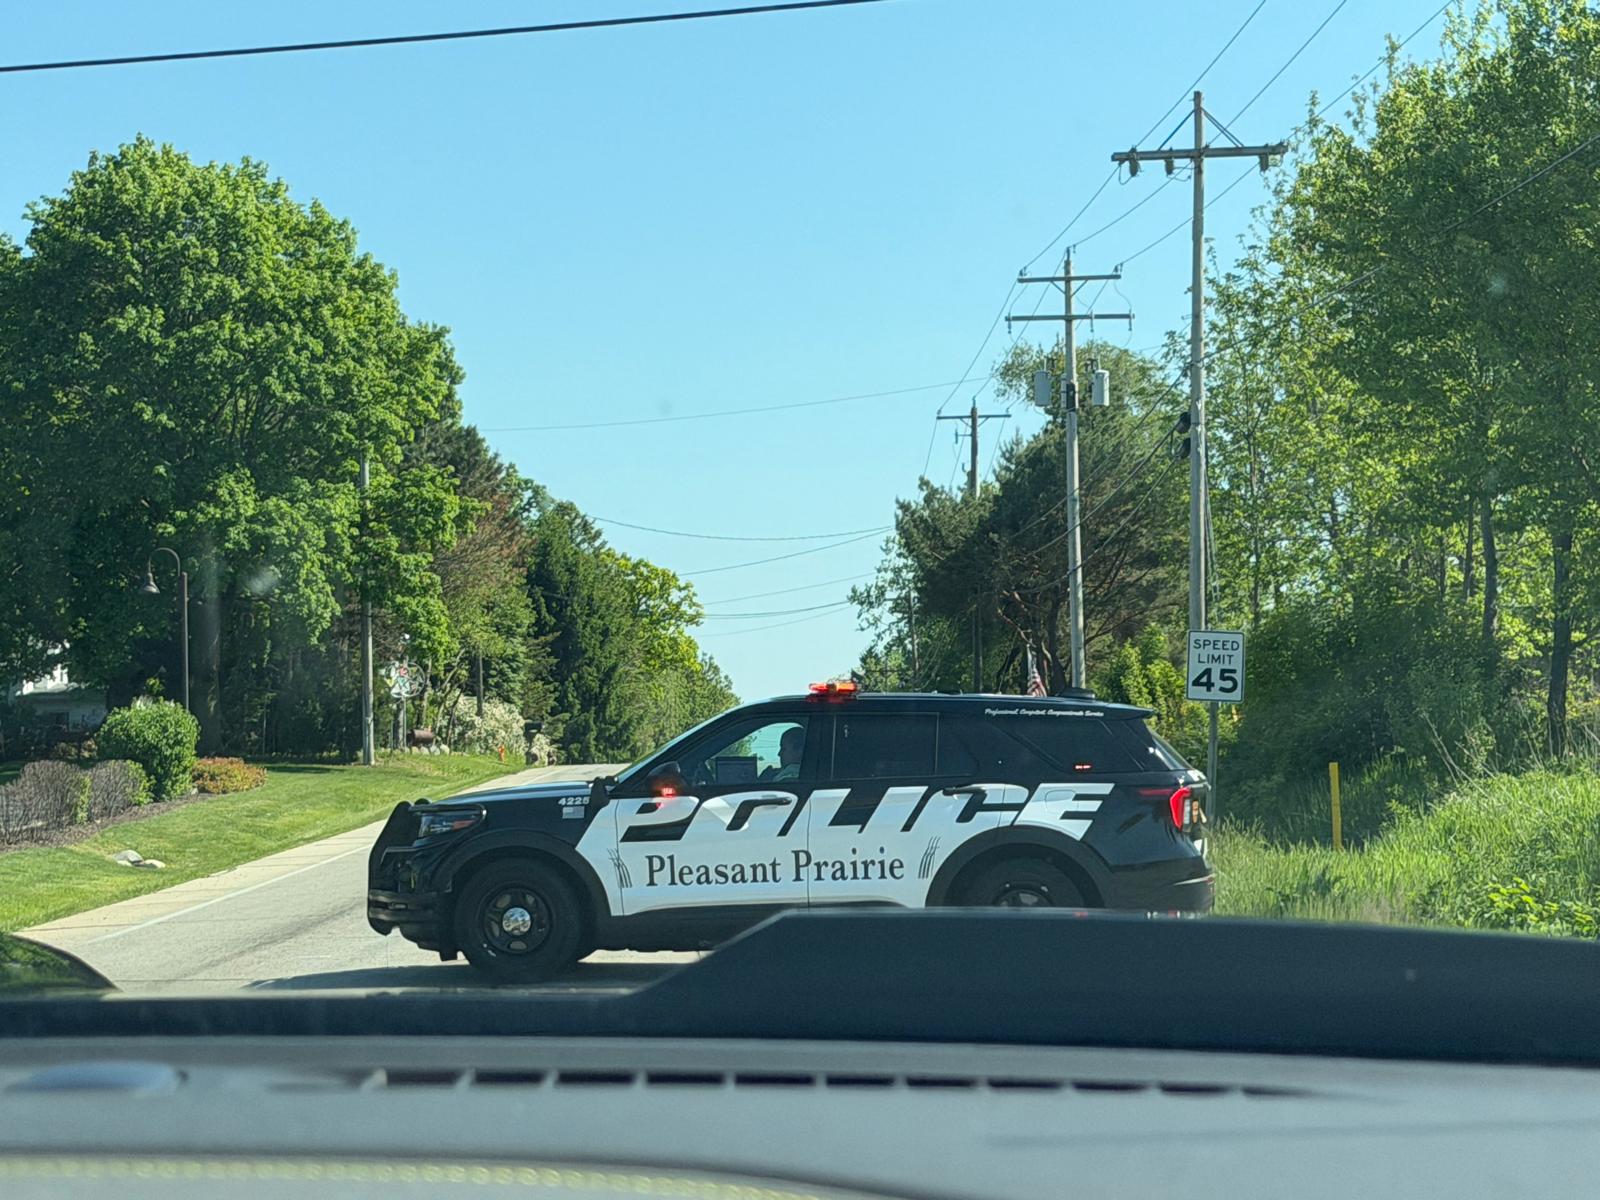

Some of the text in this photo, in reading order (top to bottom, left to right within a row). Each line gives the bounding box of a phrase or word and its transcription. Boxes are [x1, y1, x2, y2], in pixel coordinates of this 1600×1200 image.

[1193, 639, 1240, 651] SPEED
[1198, 654, 1234, 665] LIMIT
[1191, 667, 1238, 693] 45
[602, 783, 1115, 842] POLICE
[645, 846, 905, 886] Pleasant Prairie
